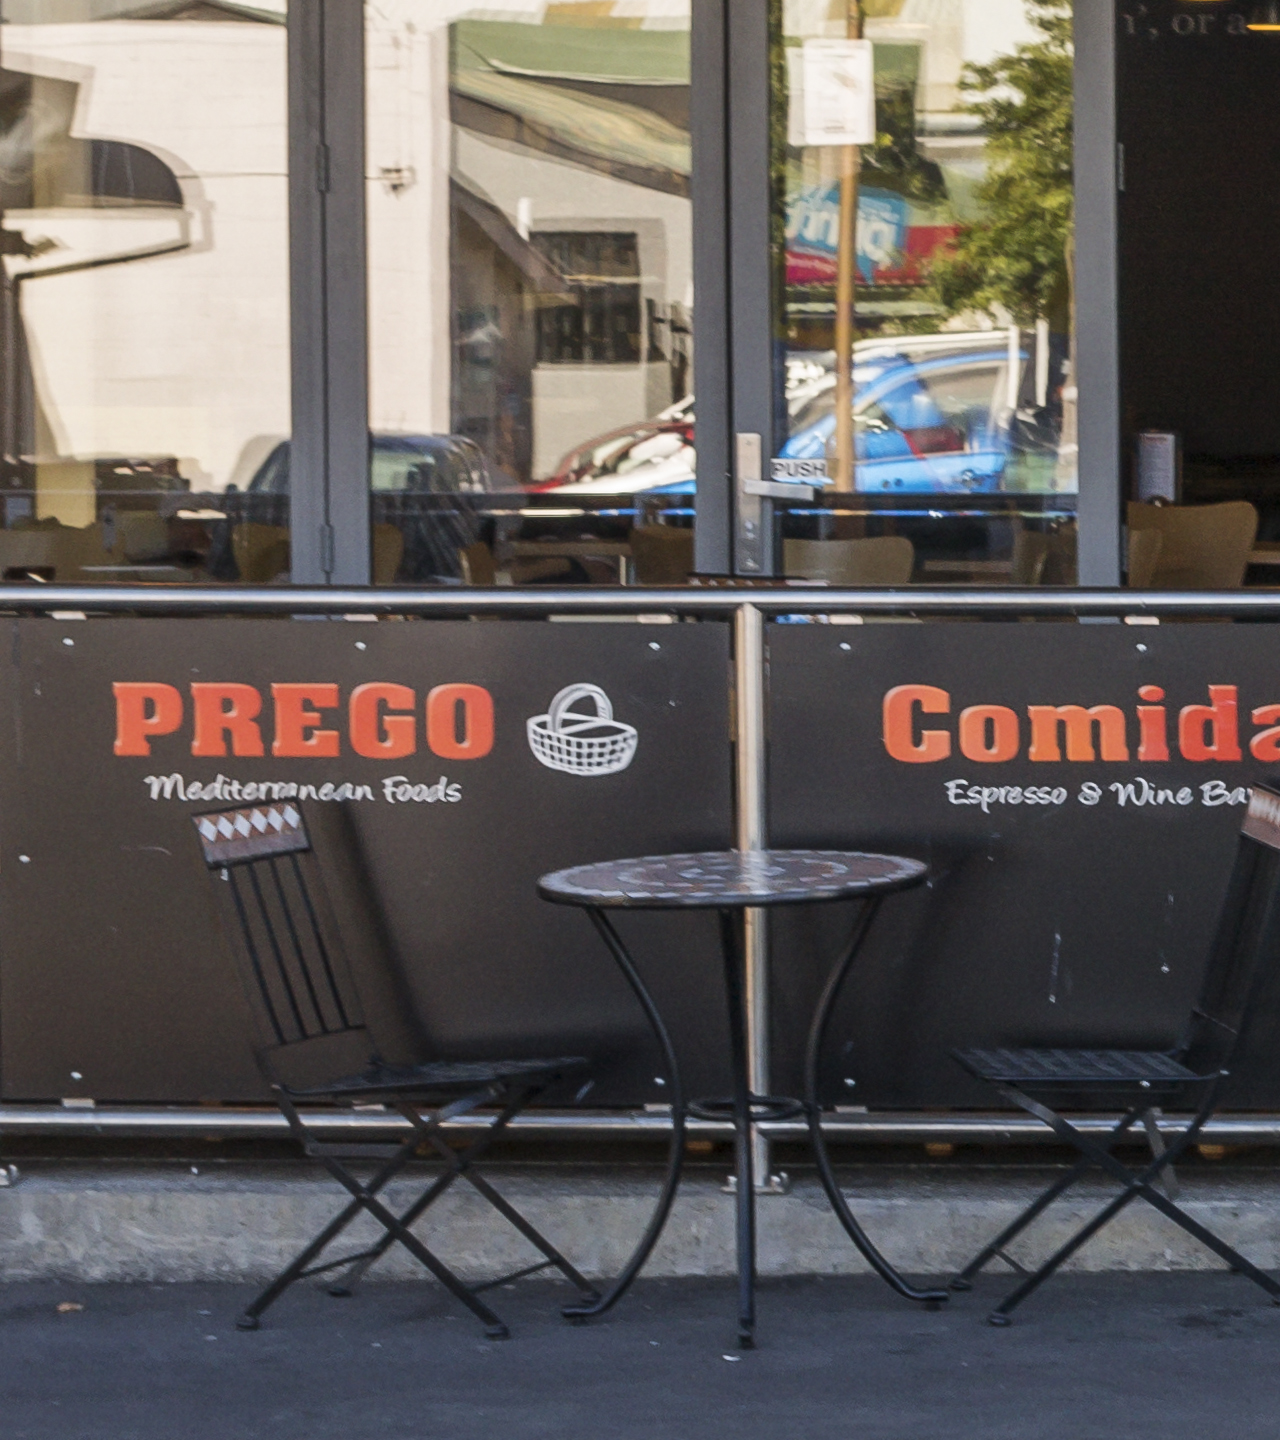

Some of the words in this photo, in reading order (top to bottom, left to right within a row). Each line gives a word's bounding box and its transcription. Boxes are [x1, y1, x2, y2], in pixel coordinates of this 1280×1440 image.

[770, 461, 826, 477] PUSH
[112, 681, 496, 760] PREGO
[143, 772, 375, 802] Mediterranean
[381, 775, 463, 804] Foods
[943, 778, 1068, 814] Espresso
[1109, 777, 1194, 807] Wine
